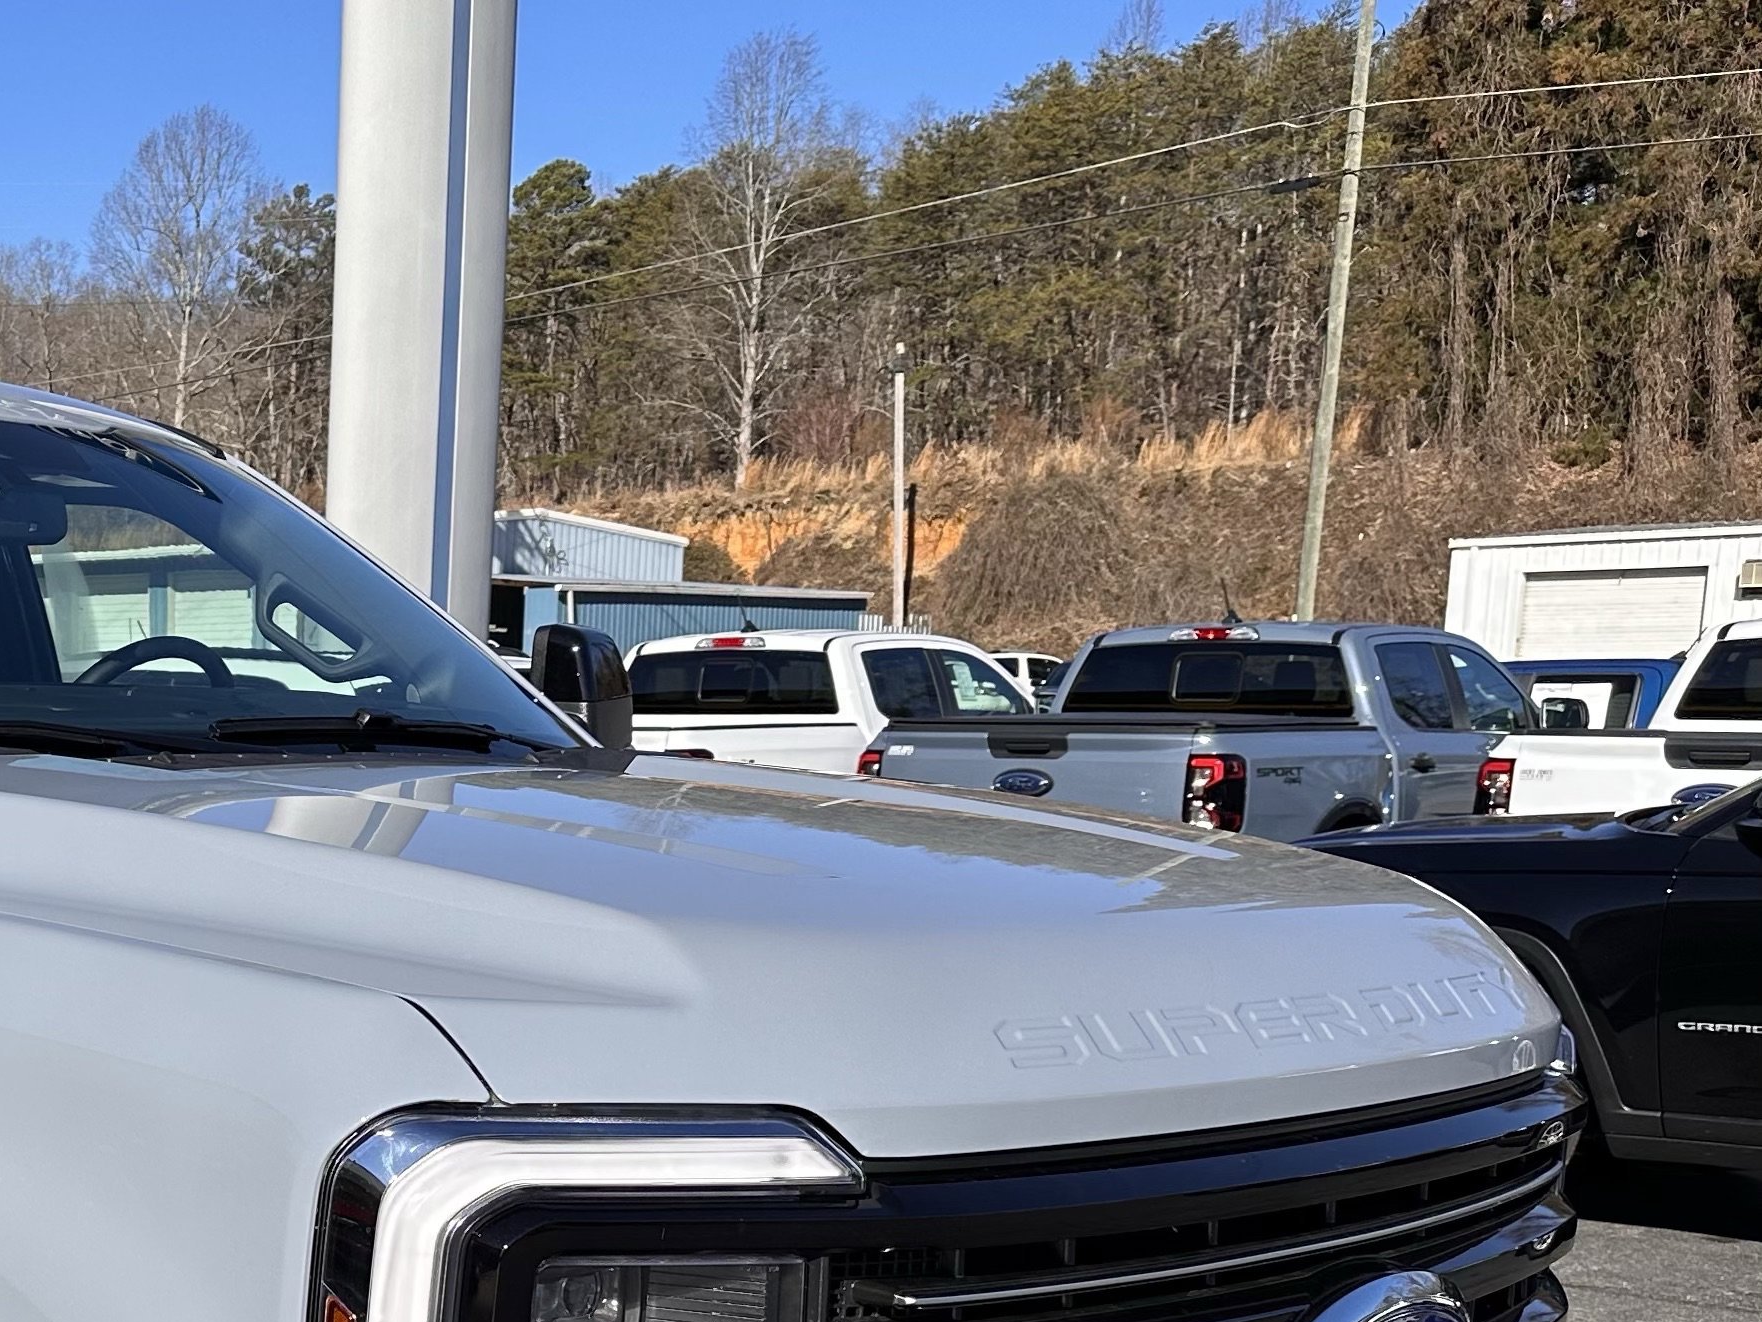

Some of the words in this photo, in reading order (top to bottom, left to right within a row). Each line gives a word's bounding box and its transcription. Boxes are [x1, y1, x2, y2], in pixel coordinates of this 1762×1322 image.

[1257, 766, 1304, 778] SPORT
[992, 993, 1368, 1070] SUPER
[1358, 966, 1527, 1031] DUTY
